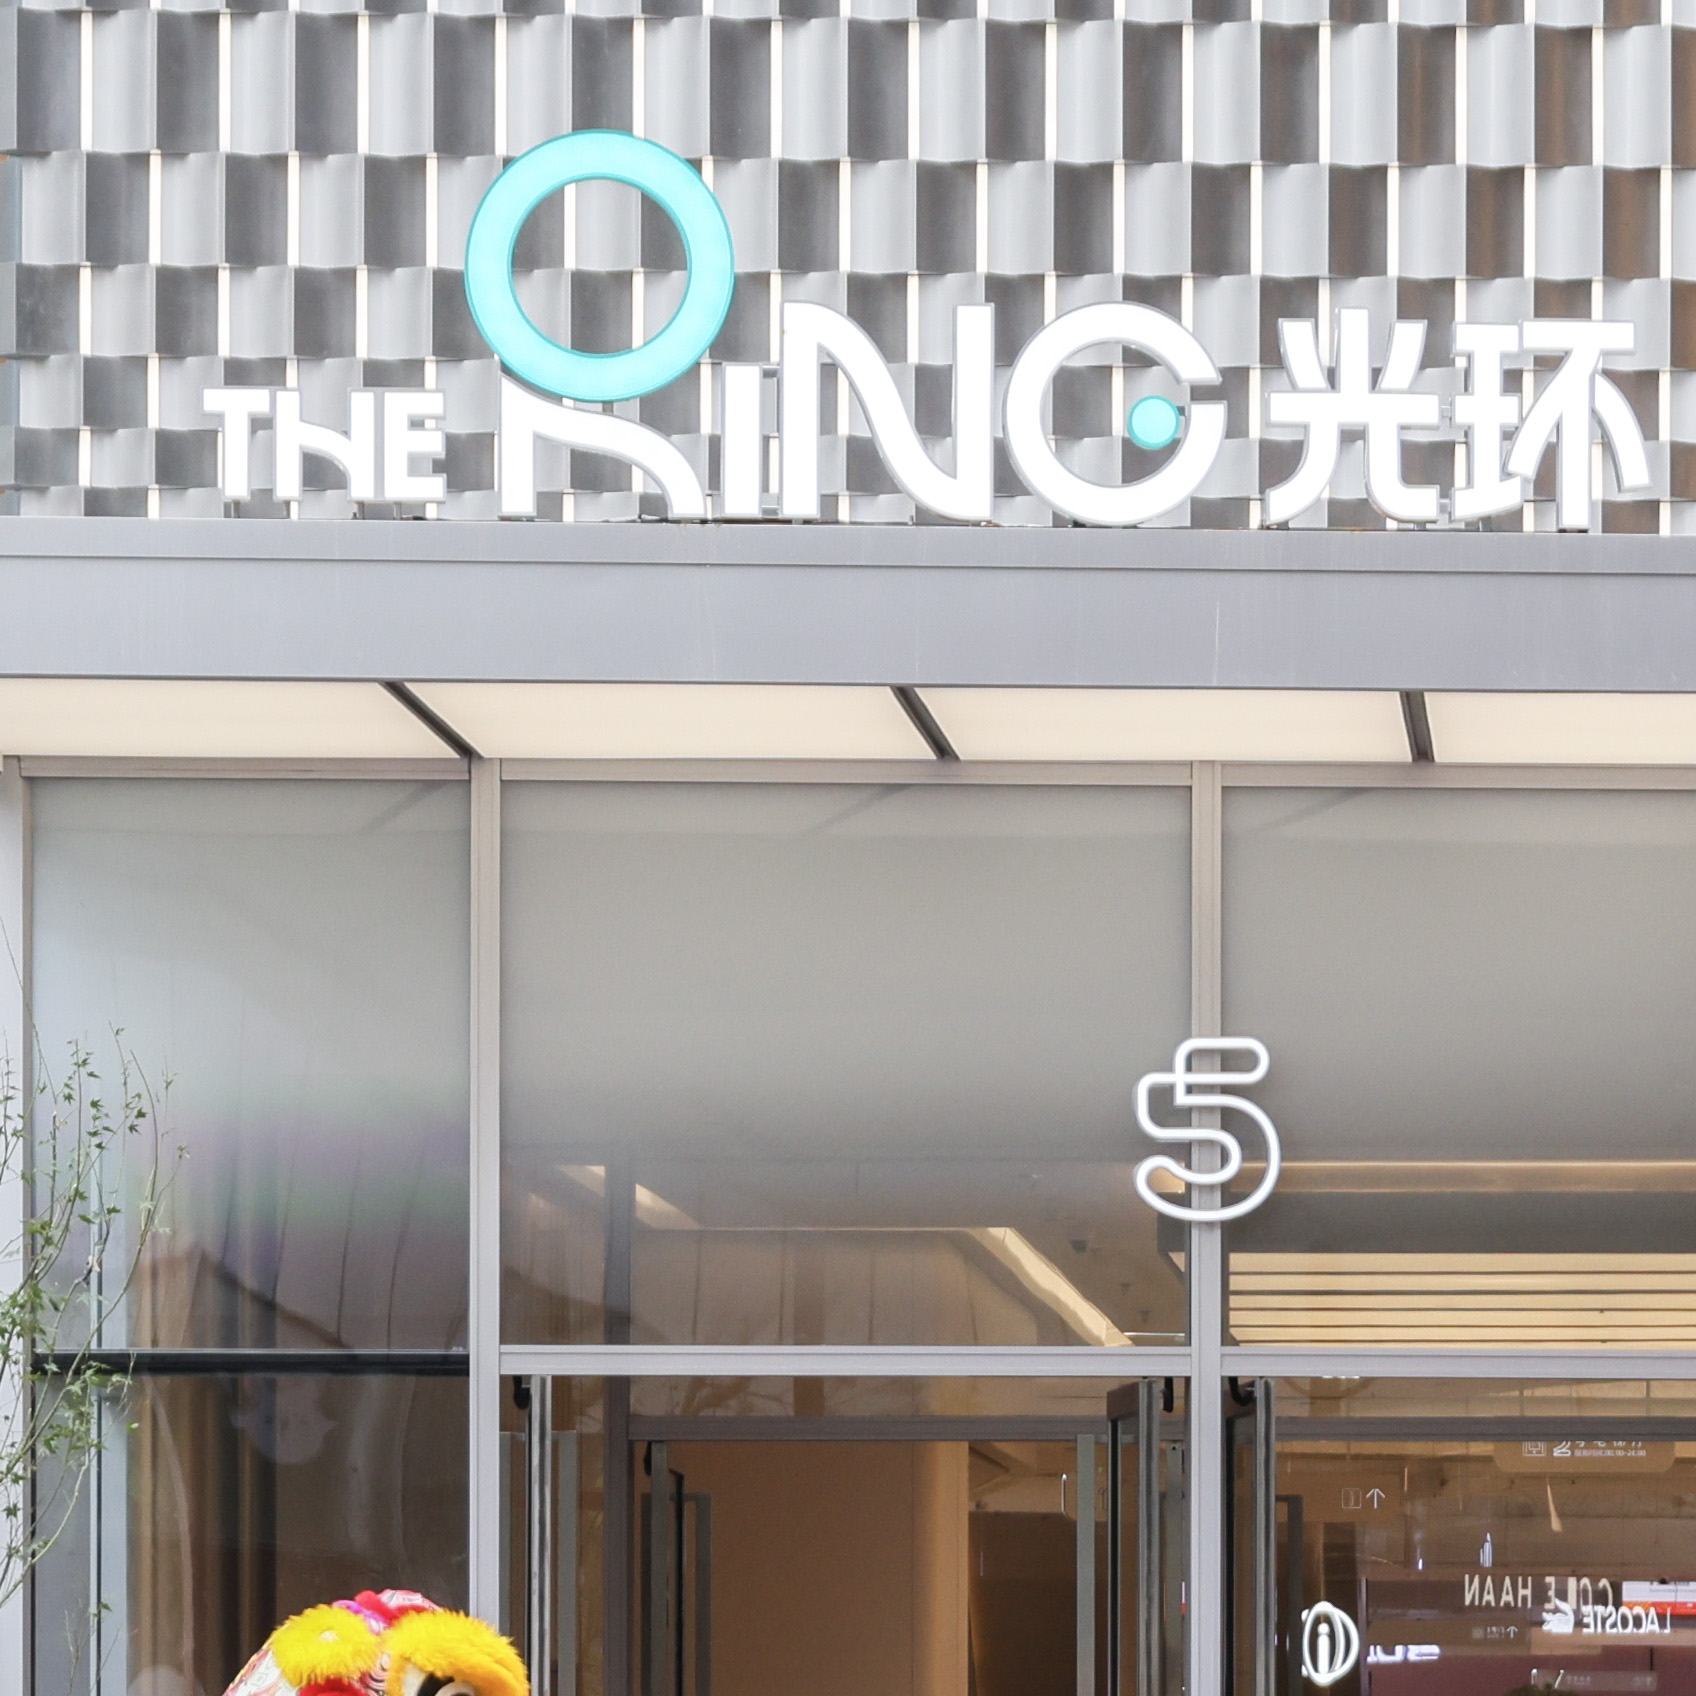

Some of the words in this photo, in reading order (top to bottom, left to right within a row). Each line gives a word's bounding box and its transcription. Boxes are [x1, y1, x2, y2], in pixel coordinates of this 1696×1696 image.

[200, 385, 446, 502] THE
[1265, 306, 1652, 530] 光环
[1135, 1037, 1281, 1221] 5
